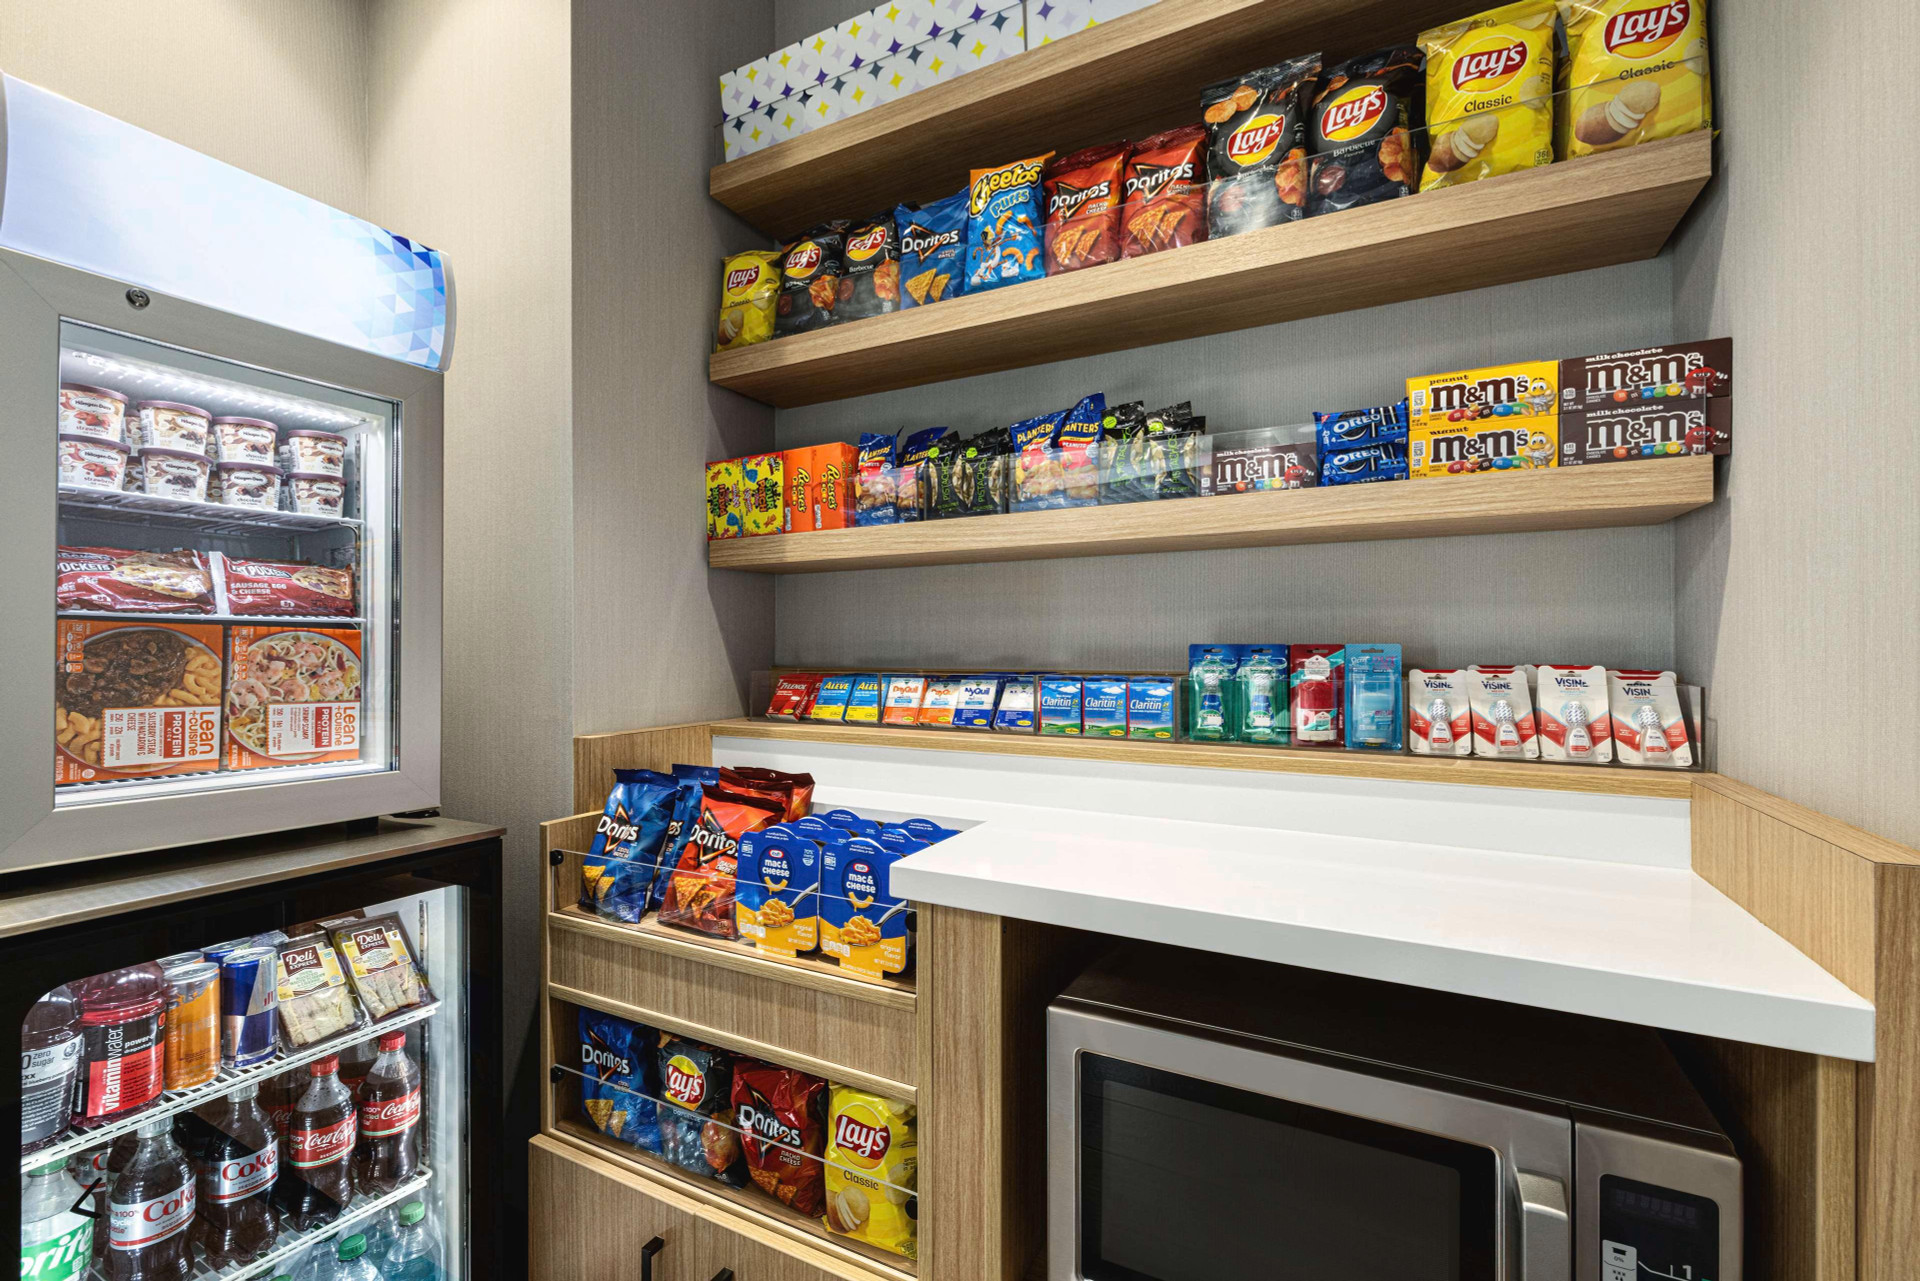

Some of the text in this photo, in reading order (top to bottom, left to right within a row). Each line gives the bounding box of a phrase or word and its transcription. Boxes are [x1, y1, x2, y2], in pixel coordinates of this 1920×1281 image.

[1611, 0, 1686, 53] Lay's
[1457, 45, 1523, 86] Lay's
[1619, 60, 1675, 80] Classic
[1325, 90, 1382, 134] Lay's
[1463, 94, 1512, 113] Classic
[1232, 120, 1280, 156] Lay's
[972, 163, 1042, 216] Cheetos
[1126, 163, 1194, 197] Doritos
[1049, 181, 1110, 215] Doritos
[901, 230, 959, 254] Doritos
[785, 248, 821, 269] Lay's
[728, 266, 759, 288] Lay's
[1585, 347, 1663, 363] milk chocolate
[1429, 374, 1469, 385] peanut
[1586, 352, 1703, 395] m&m's
[1430, 375, 1529, 412] m&m's
[1333, 414, 1380, 433] OREO
[1586, 404, 1664, 418] milk chocolate
[1065, 421, 1099, 433] ANTERS
[1586, 410, 1704, 451] m&m's
[1333, 449, 1380, 465] OREO
[1430, 429, 1529, 463] m&m's
[1217, 453, 1298, 485] m&m's
[758, 480, 768, 513] PATCH
[765, 479, 775, 511] SOUR
[797, 467, 811, 513] Reese's
[826, 463, 841, 511] Reese's
[824, 681, 849, 690] ALEVE
[892, 685, 918, 695] DayQuil
[964, 687, 991, 696] NyQuil
[1481, 681, 1513, 690] VISINE
[1042, 696, 1072, 707] Claritin
[1085, 697, 1116, 708] Claritin
[1130, 699, 1162, 710] Claritin
[127, 712, 136, 732] CHEESE
[147, 712, 156, 755] SALISBURY STEAK
[173, 713, 182, 757] PROTEIN
[199, 710, 214, 755] Lean
[321, 708, 330, 746] PROTEIN
[344, 706, 356, 745] Lean
[765, 859, 788, 869] mac &
[849, 873, 874, 885] mac &
[357, 931, 384, 947] Deli
[286, 950, 315, 965] Deli
[31, 1056, 56, 1068] sugar
[32, 1050, 51, 1060] zero
[581, 1044, 630, 1074] Doritos
[304, 1117, 355, 1151] Coca-Cola
[739, 1105, 801, 1146] Doritos
[837, 1116, 888, 1157] Lay's
[222, 1148, 278, 1182] Coke
[779, 1155, 801, 1167] CHEESE
[780, 1150, 800, 1161] NACHO
[843, 1170, 879, 1190] Classic
[143, 1186, 196, 1222] Coke
[21, 1226, 94, 1277] prite
